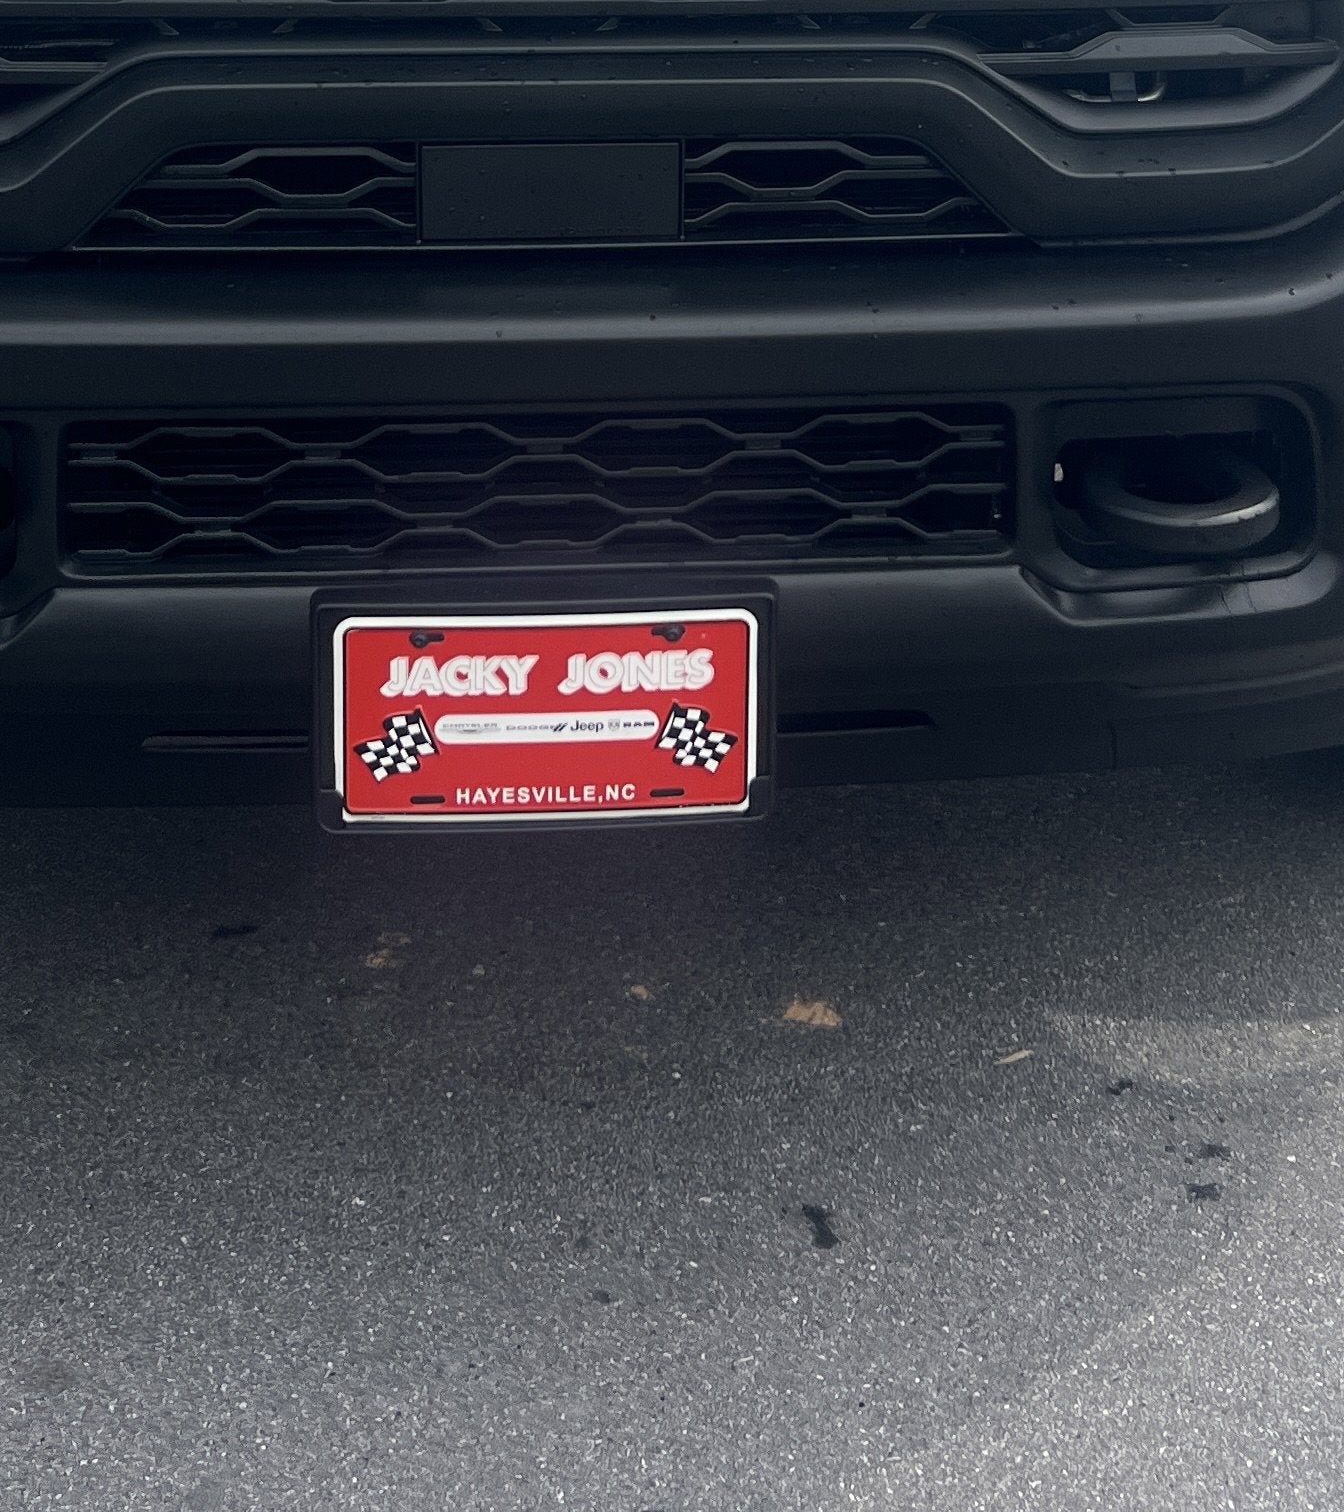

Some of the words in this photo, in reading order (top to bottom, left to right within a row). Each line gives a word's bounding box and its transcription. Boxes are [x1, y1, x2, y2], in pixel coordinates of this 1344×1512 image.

[379, 654, 540, 697] JACKY
[557, 647, 715, 695] JONES
[570, 719, 604, 733] Jeep
